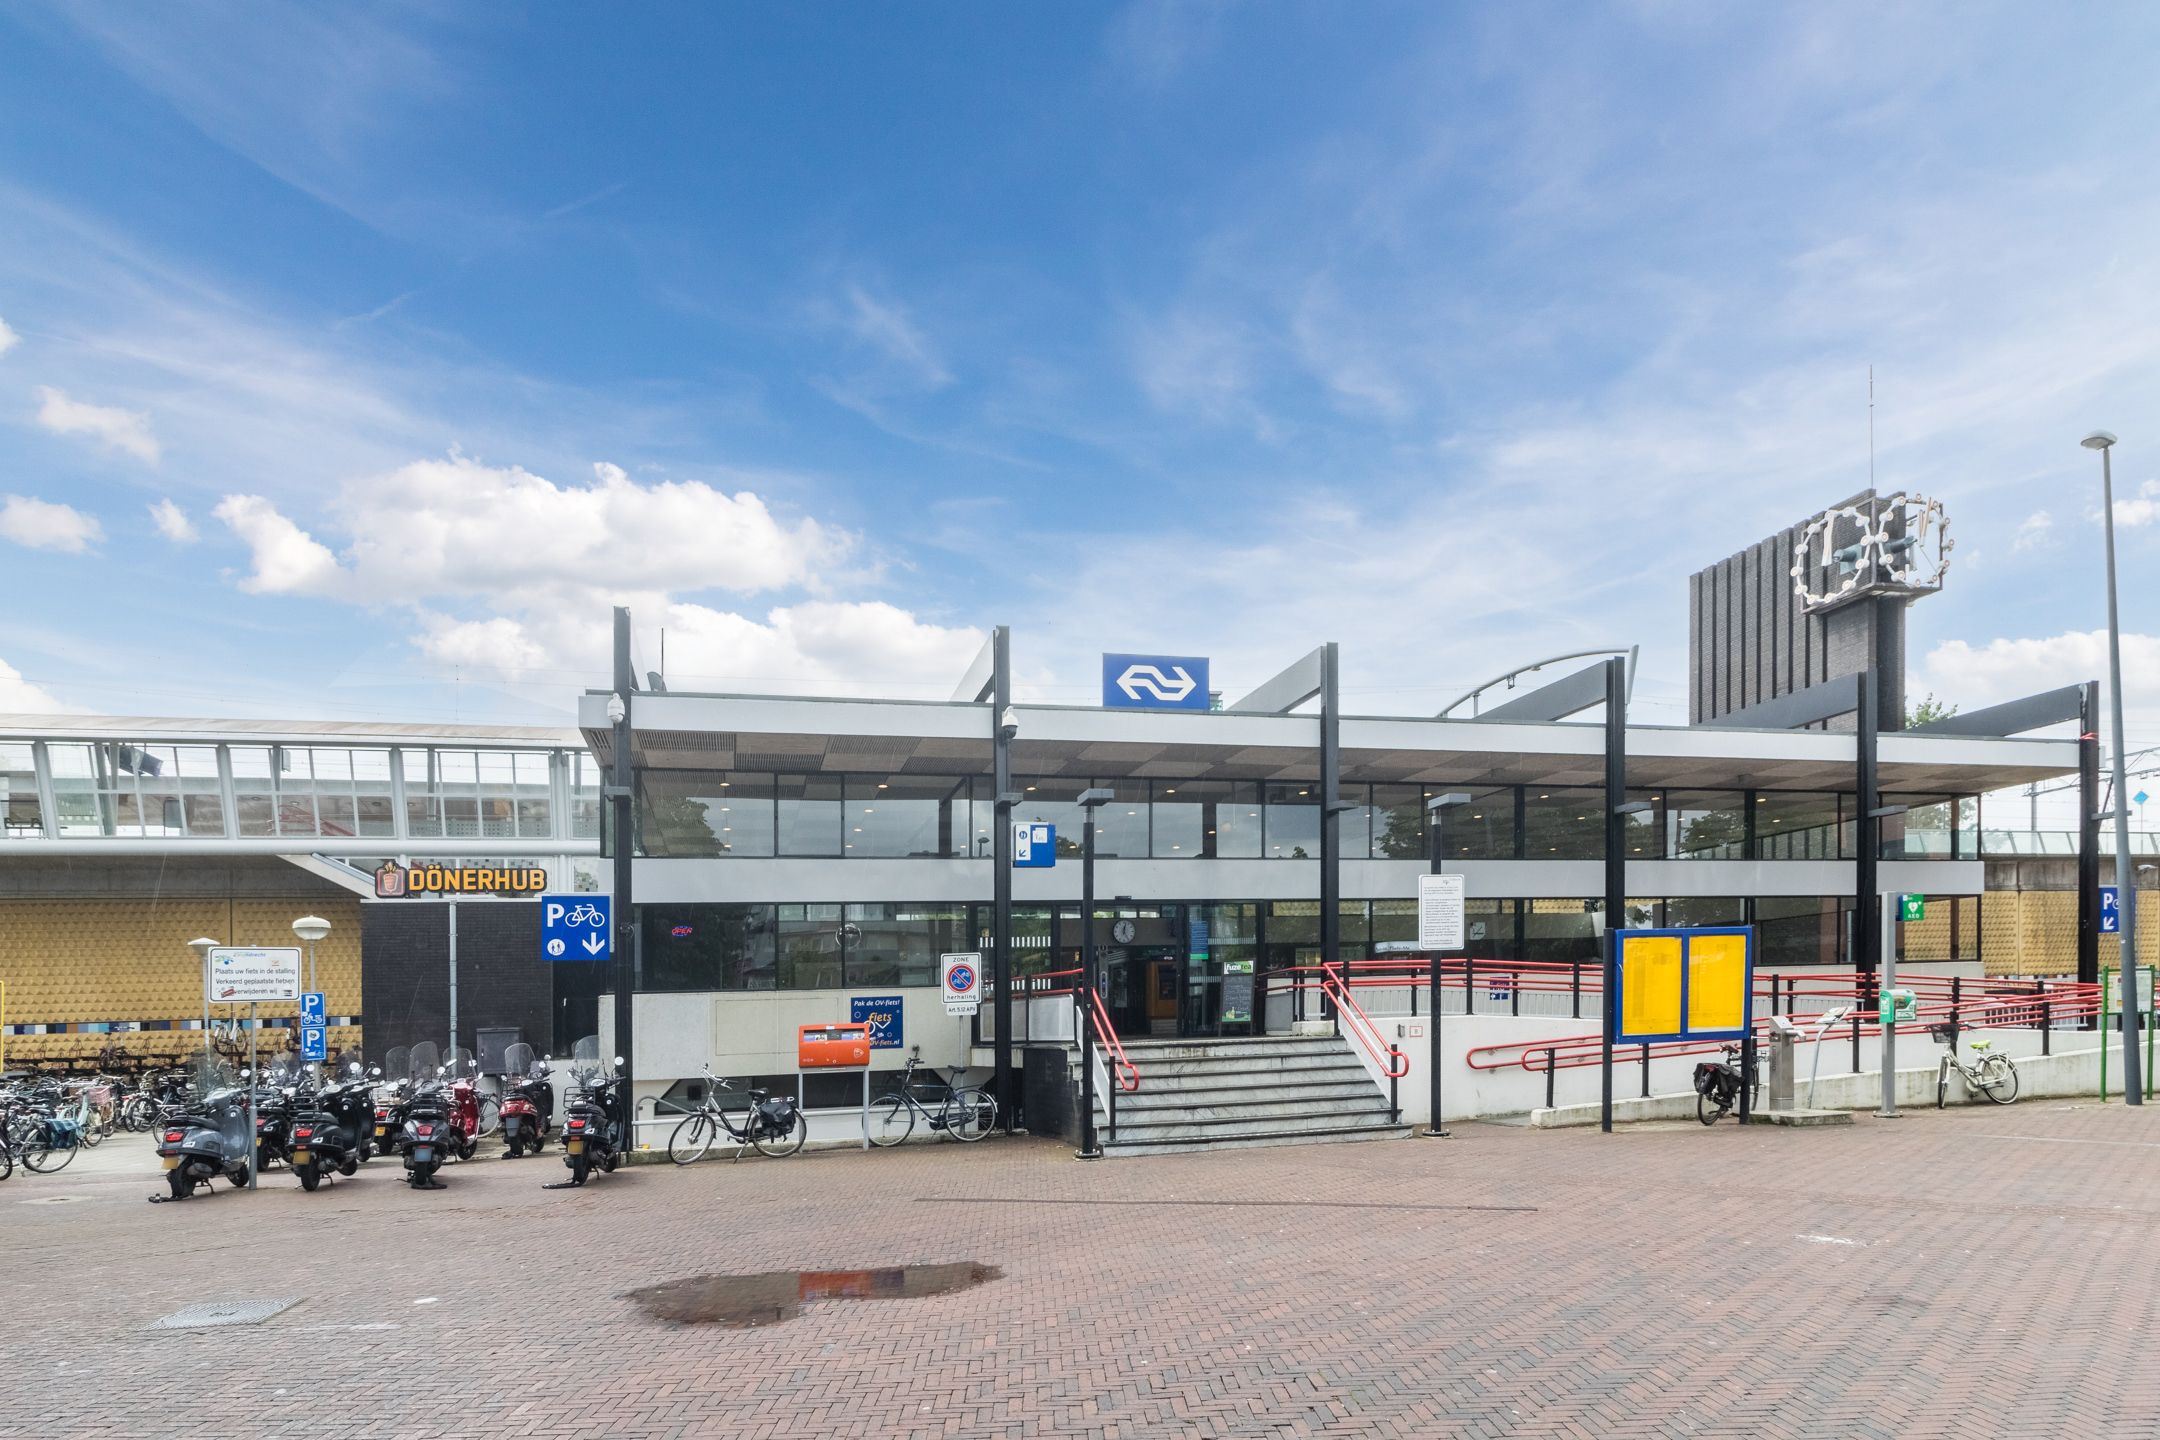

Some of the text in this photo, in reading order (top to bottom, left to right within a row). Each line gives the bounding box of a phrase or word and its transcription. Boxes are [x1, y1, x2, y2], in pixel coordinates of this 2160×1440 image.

[409, 864, 545, 891] DÖNERHUB
[2103, 892, 2113, 910] P
[547, 903, 565, 928] P
[671, 926, 693, 935] OPEN
[274, 968, 296, 977] stalling
[243, 978, 274, 986] geplaatste
[269, 988, 278, 996] wij
[305, 995, 319, 1013] P
[874, 999, 900, 1007] OV-fiets!
[868, 1011, 892, 1027] fiets
[306, 1030, 320, 1047] P
